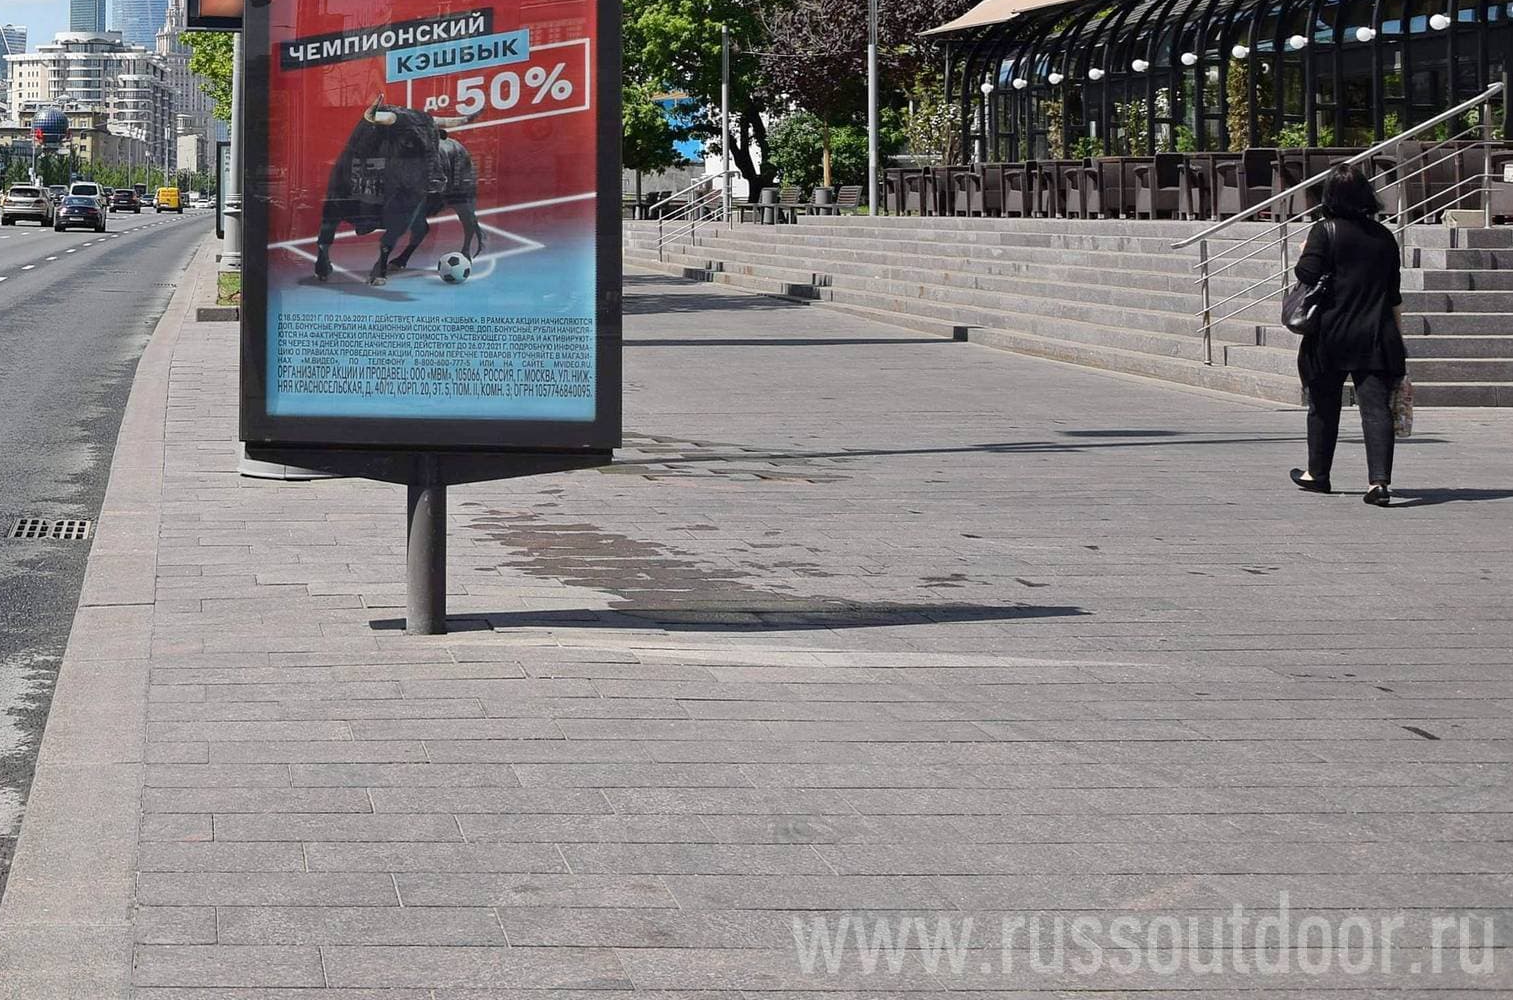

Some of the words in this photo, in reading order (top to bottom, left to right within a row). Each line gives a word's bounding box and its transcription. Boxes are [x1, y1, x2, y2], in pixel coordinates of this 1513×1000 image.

[289, 11, 485, 63] ЧЕМПИОНСКИЙ
[396, 38, 519, 75] КЭШБЫК
[455, 62, 573, 117] 50%
[417, 315, 439, 324] АКЦИЯ
[486, 316, 515, 324] РАМКАХ
[516, 317, 540, 325] АКЦИИ
[296, 322, 332, 330] БОНУСНЫЕ
[414, 324, 442, 332] СПИСОК
[495, 325, 531, 333] БОНУСНЫЕ
[289, 339, 311, 347] ЧЕРЕЗ
[320, 339, 339, 348] ДНЕЙ
[340, 340, 362, 348] ПОСЛЕ
[509, 334, 535, 342] ТОВАРА
[278, 348, 294, 356] ЦИЮ
[302, 348, 339, 356] ПРАВИЛАХ
[446, 350, 478, 358] ПЕРЕЧНЕ
[522, 359, 544, 367] САЙТЕ
[332, 366, 358, 380] АКЦИИ
[410, 367, 426, 380] ООО
[278, 380, 293, 393] НЯЯ
[514, 383, 533, 397] ОГРН
